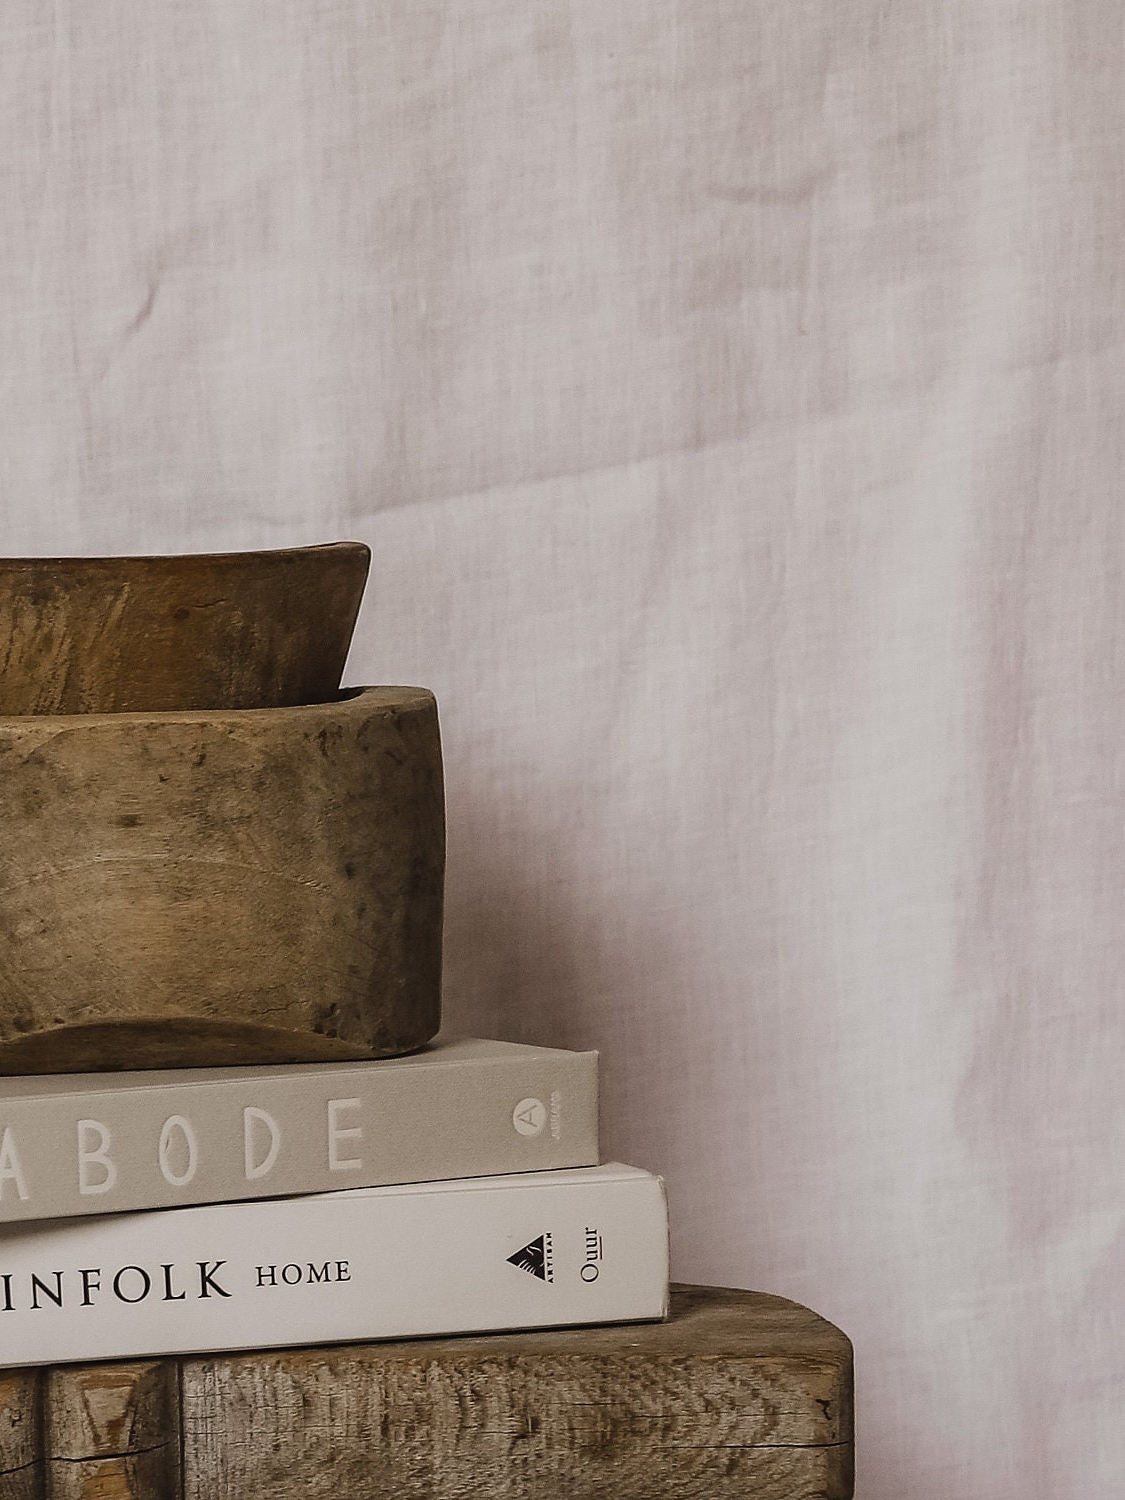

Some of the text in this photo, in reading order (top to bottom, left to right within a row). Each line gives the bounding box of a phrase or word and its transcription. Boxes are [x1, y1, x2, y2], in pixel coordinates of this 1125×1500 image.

[254, 1259, 353, 1287] HOME
[545, 1232, 554, 1284] ARTISAN
[580, 1226, 601, 1283] Ouur
